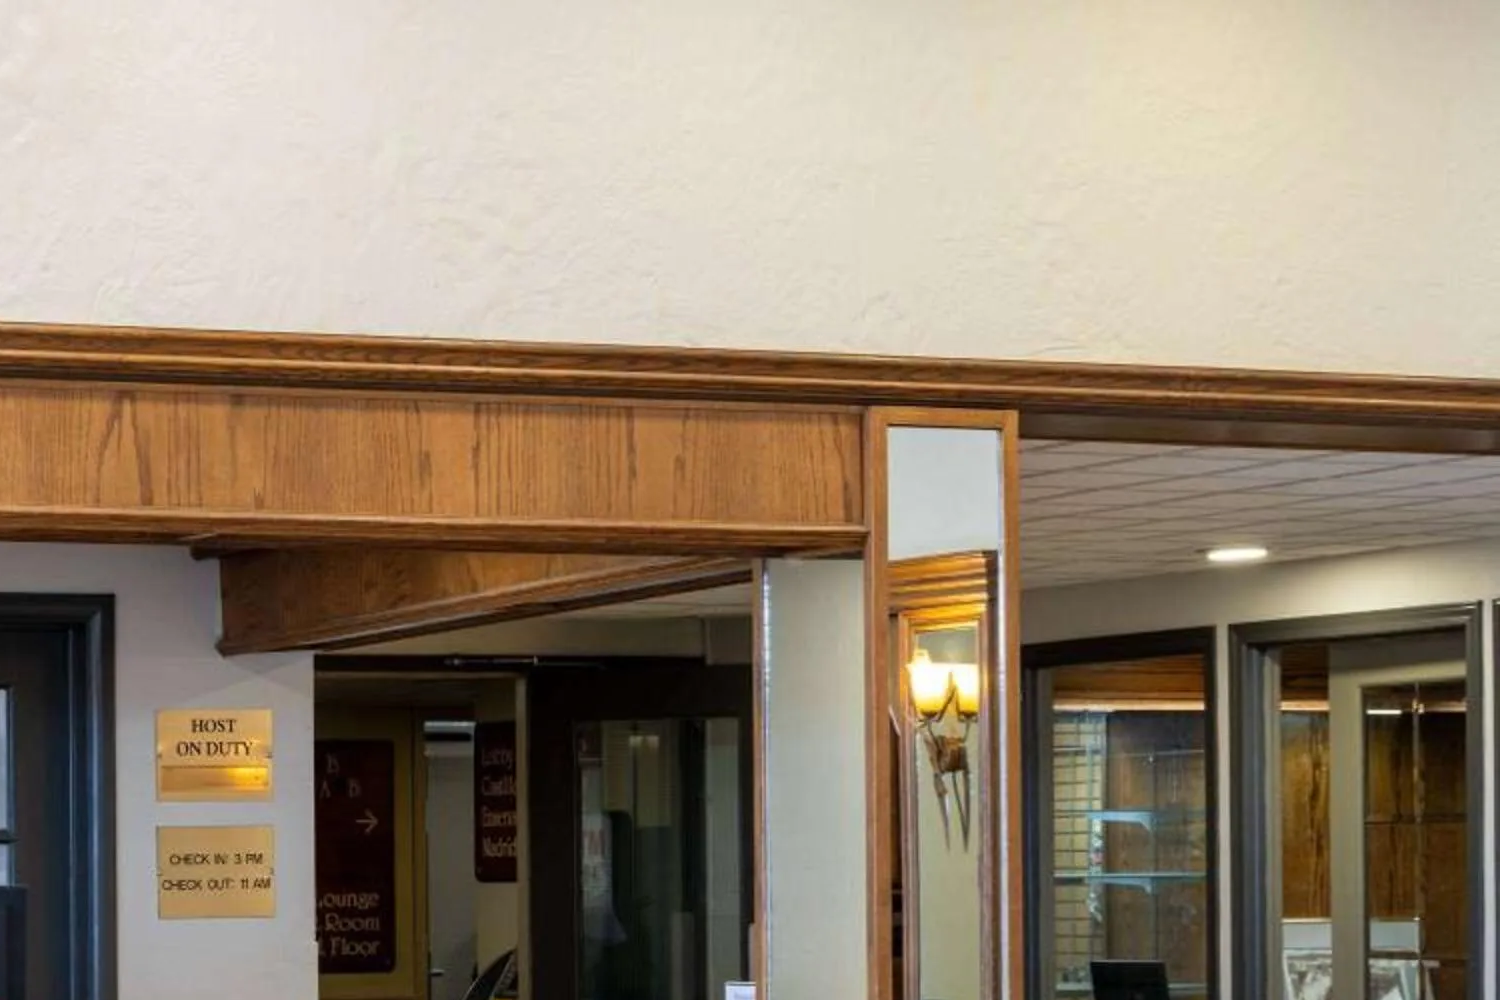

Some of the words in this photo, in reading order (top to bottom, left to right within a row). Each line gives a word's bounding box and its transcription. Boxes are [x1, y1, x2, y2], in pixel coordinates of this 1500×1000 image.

[191, 719, 238, 733] HOST
[176, 742, 201, 757] ON
[206, 741, 253, 757] DUTY
[169, 854, 210, 866] CHECK
[234, 854, 242, 865] 3
[246, 854, 263, 865] PM
[162, 879, 202, 891] CHECK
[241, 878, 249, 890] 11
[253, 878, 271, 889] AM
[319, 892, 380, 909] ounge
[325, 912, 380, 932] Room
